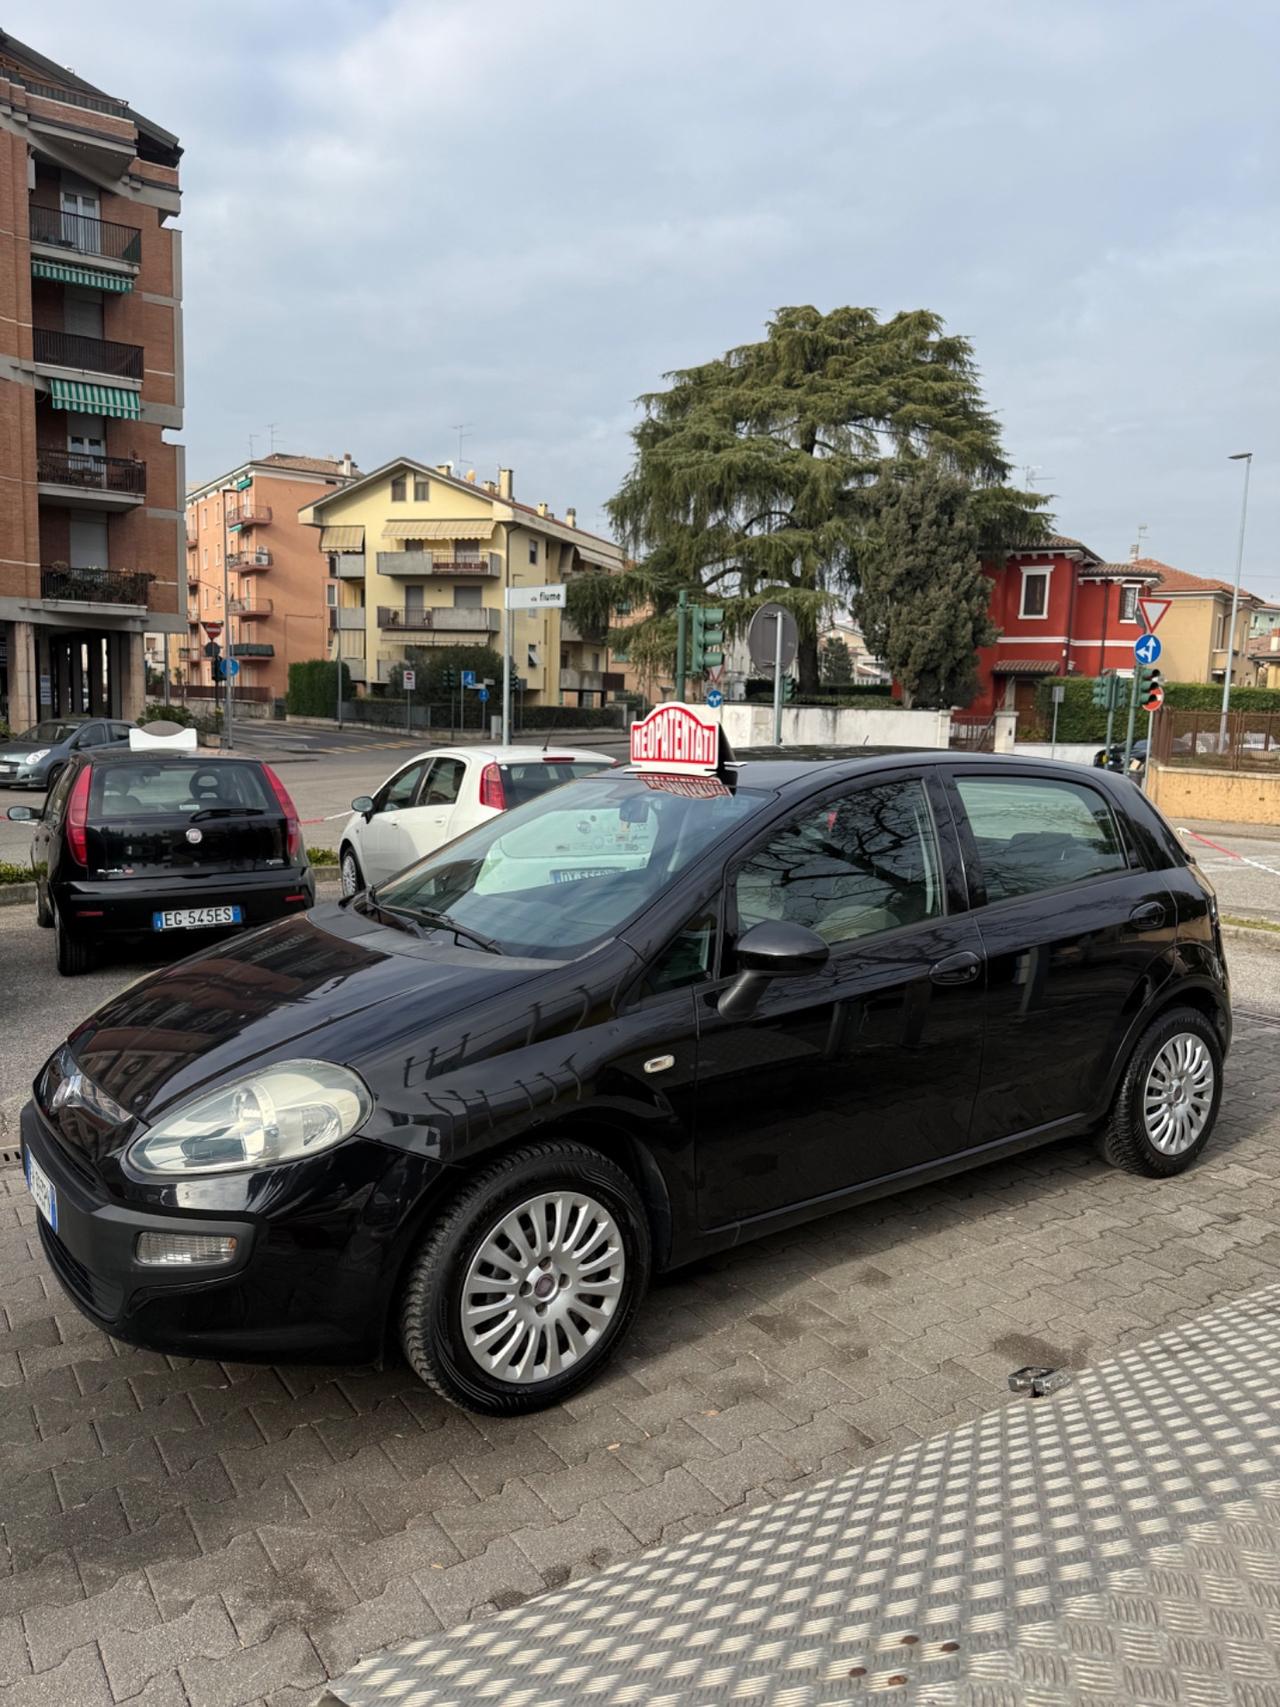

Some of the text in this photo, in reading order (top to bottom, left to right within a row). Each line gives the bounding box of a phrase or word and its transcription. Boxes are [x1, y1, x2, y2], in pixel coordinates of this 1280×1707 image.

[633, 708, 714, 762] NEOPATENTATI
[164, 907, 232, 927] EG 545ES
